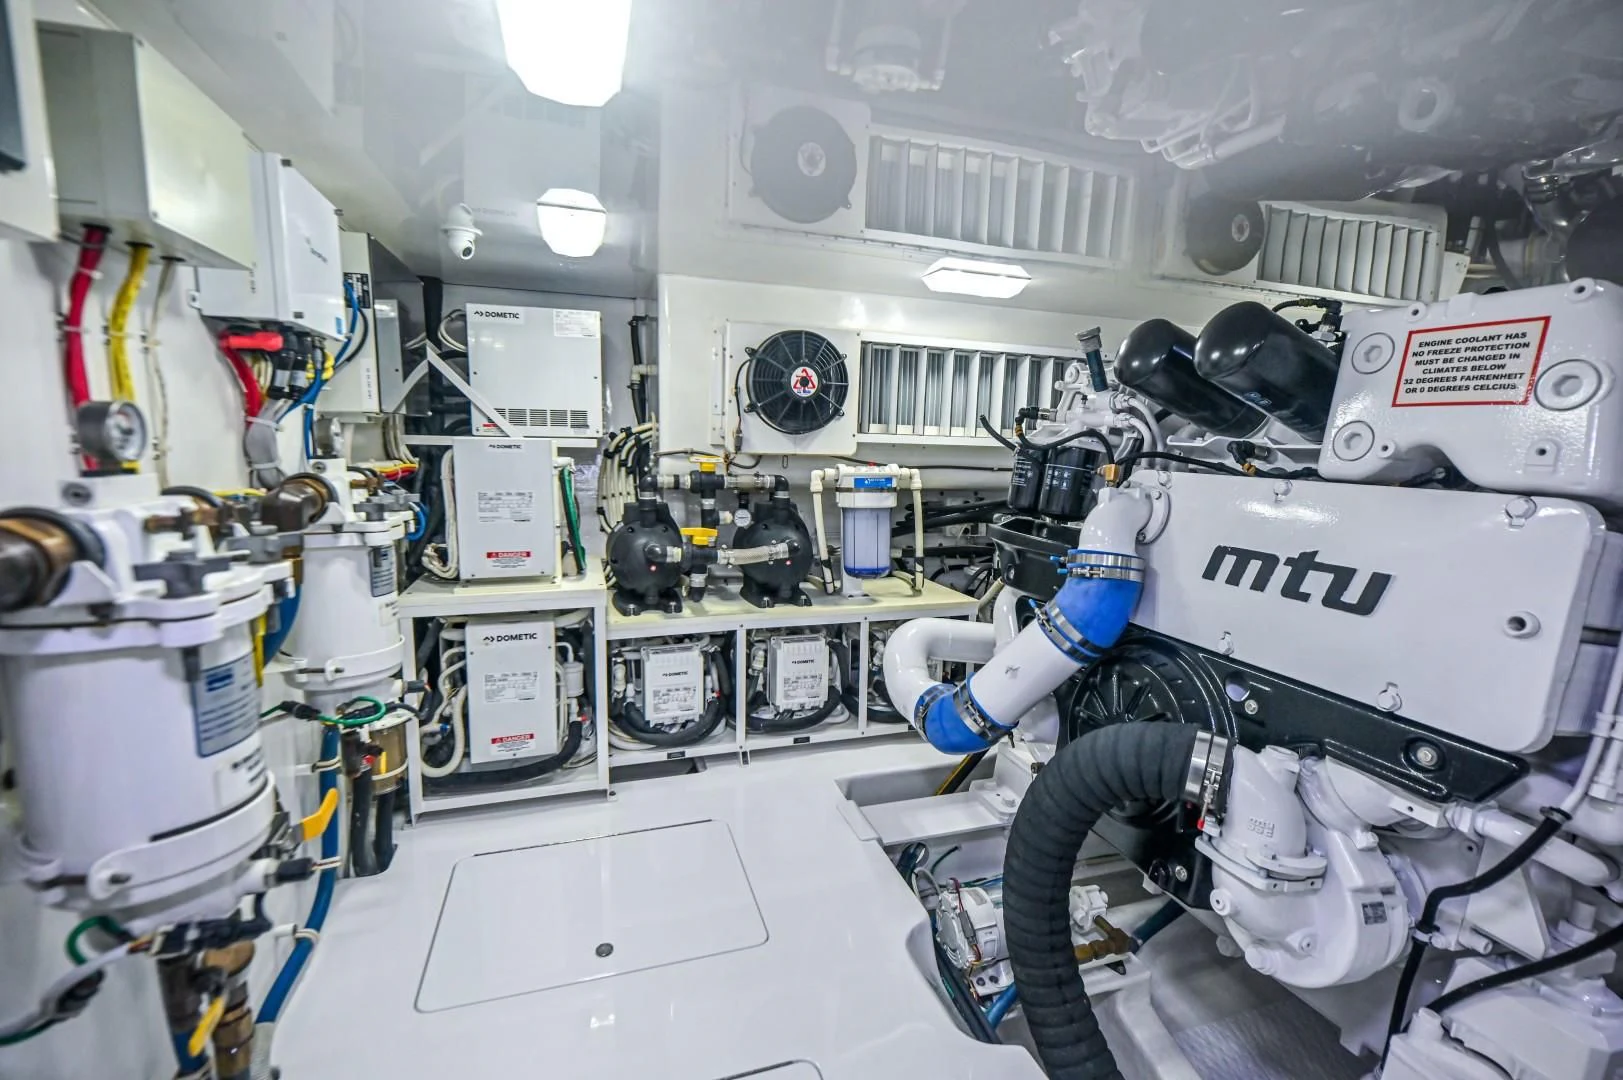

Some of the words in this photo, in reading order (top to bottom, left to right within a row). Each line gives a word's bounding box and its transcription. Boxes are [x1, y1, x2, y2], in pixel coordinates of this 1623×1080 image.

[1418, 339, 1453, 348] ENGINE
[1455, 334, 1502, 344] COOLANT
[1505, 332, 1527, 340] HAS
[1427, 347, 1462, 356] FREEZE
[1464, 342, 1530, 353] PROTECTION
[1415, 358, 1440, 366] MUST
[1458, 354, 1506, 363] CHANGED
[1422, 366, 1468, 375] CLIMATES
[1416, 374, 1458, 384] DEGREES
[1460, 372, 1525, 382] FAHRENHEIT
[1405, 386, 1417, 394] OR
[1428, 384, 1470, 392] DEGREES
[1202, 544, 1392, 616] mtu
[496, 632, 538, 642] DOMETIC
